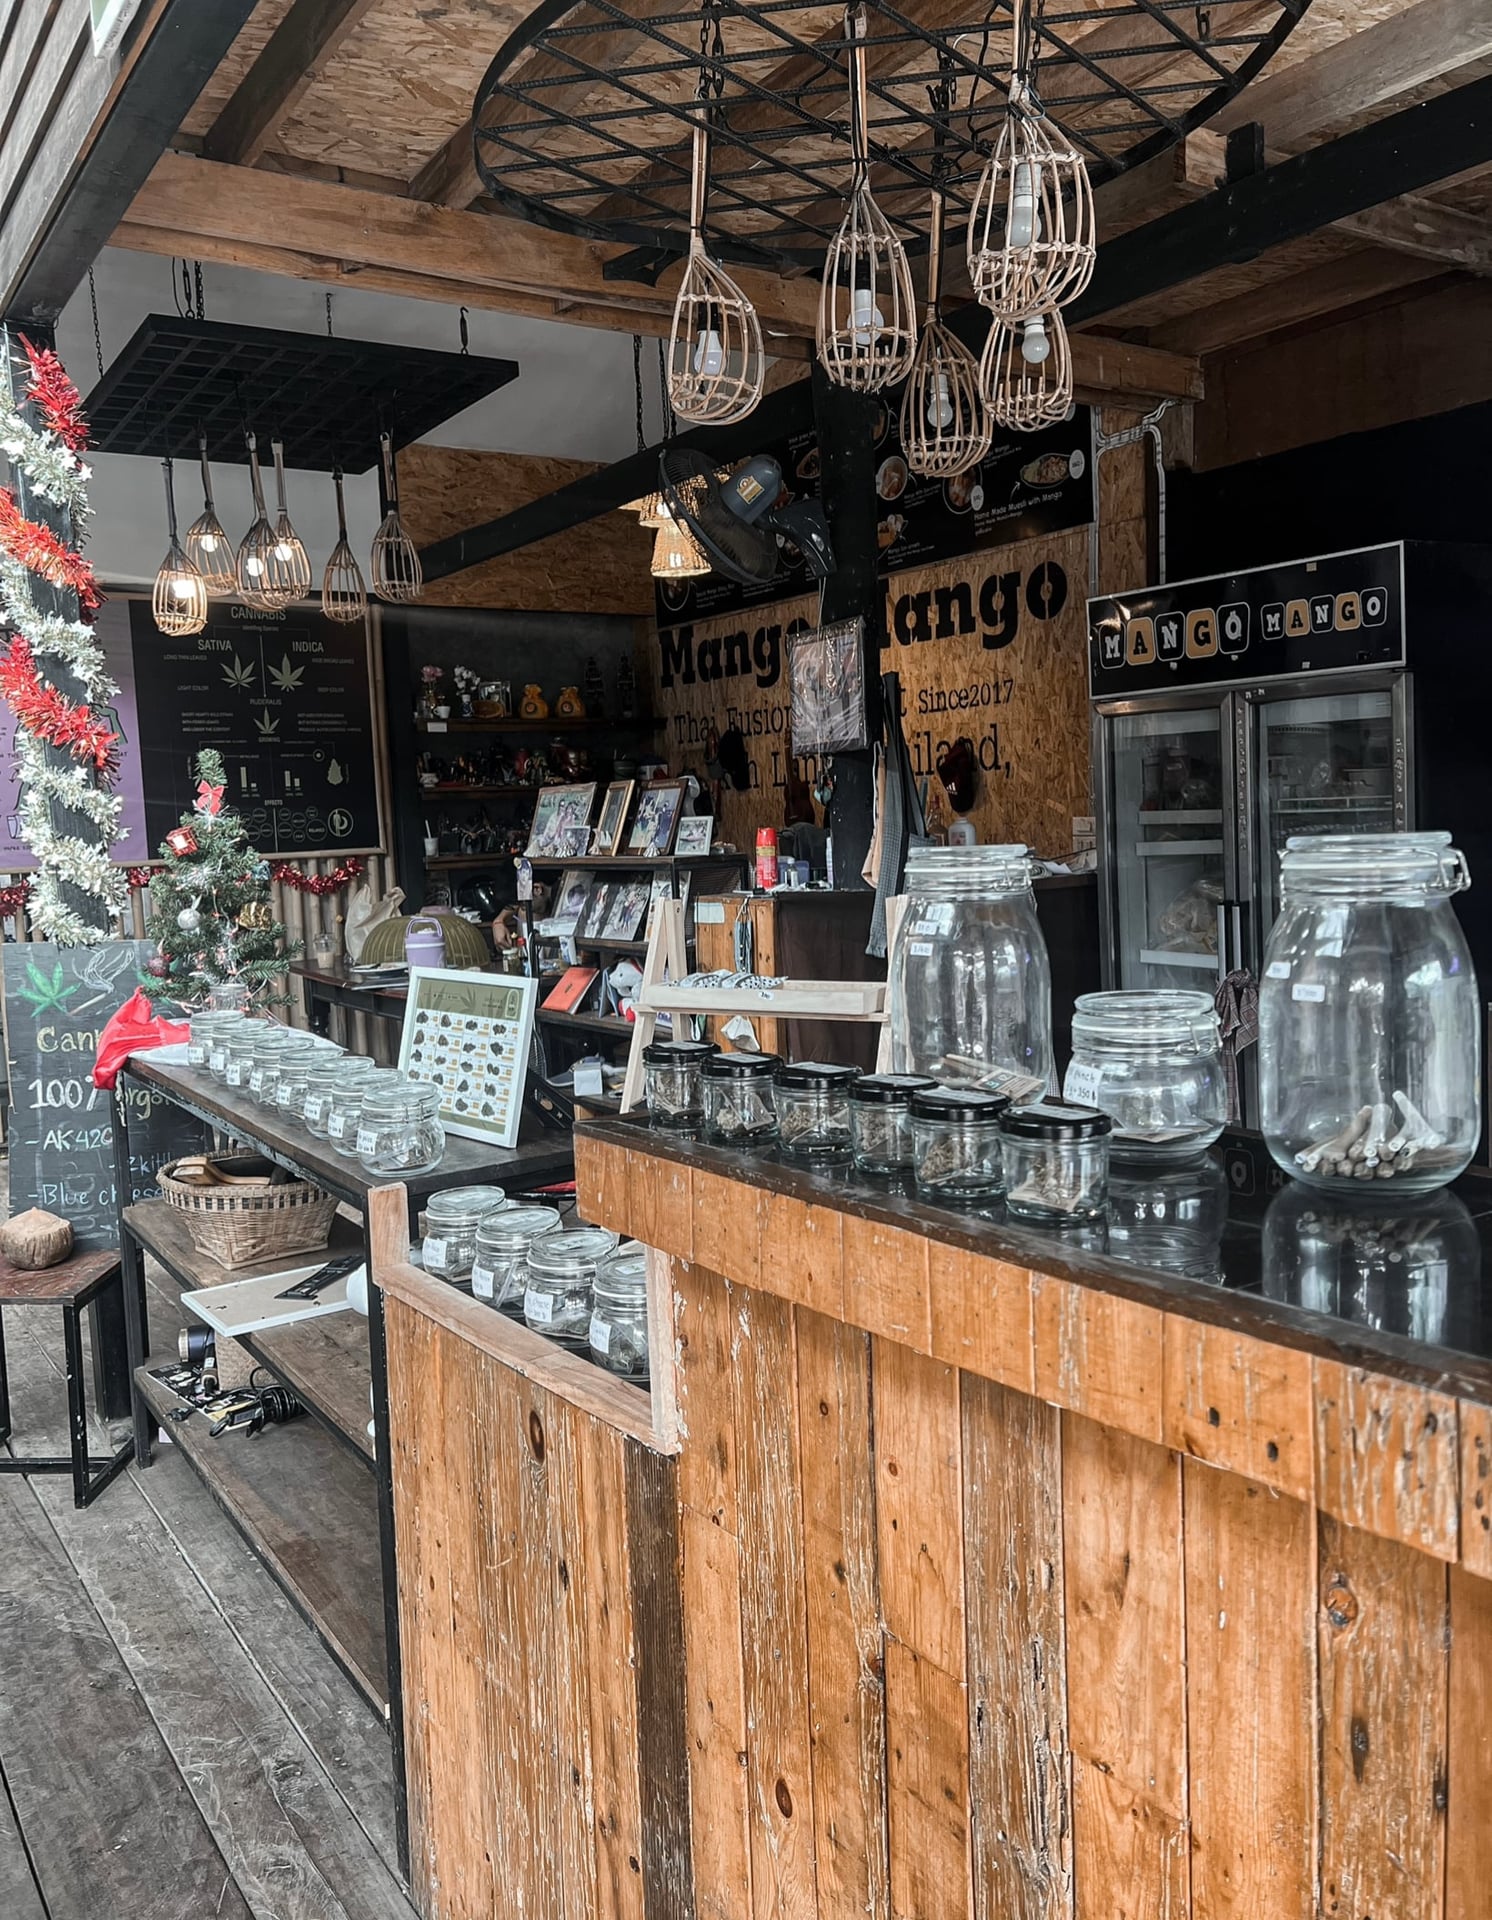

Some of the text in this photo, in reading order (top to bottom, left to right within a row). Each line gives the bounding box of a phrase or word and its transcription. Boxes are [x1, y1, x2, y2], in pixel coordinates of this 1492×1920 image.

[230, 605, 287, 621] CANNABIS
[1104, 596, 1381, 660] MANGO MANGO
[198, 639, 325, 653] SATIVA INDICA
